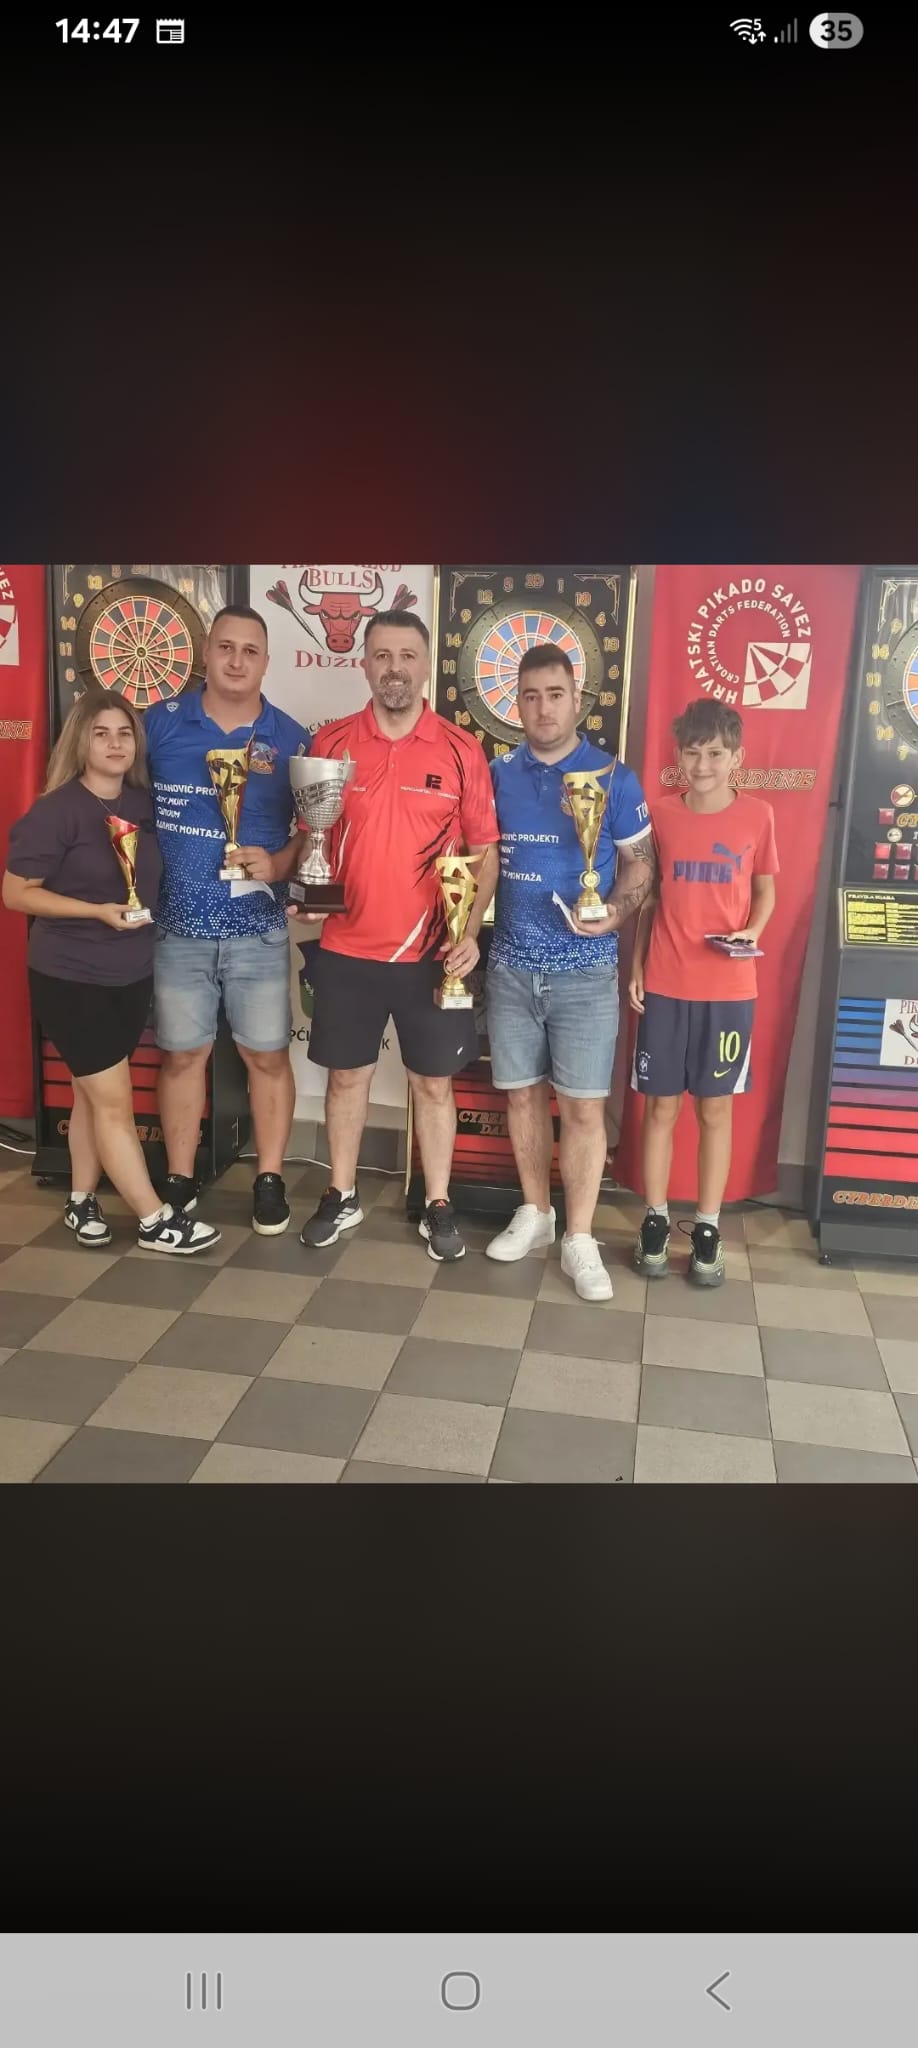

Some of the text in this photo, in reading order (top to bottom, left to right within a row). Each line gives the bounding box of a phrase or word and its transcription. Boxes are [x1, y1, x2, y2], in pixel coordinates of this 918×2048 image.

[308, 568, 373, 589] BULLS
[445, 633, 462, 648] 14
[687, 578, 812, 704] HRVATSKI PIKADO SAVEZ
[706, 599, 791, 684] CROATIAN DARTS FEDERATION
[660, 766, 817, 791] CYRDINE
[195, 786, 218, 797] PRO
[180, 825, 227, 840] MONTAŽA
[518, 833, 560, 844] PROJEKTI
[673, 860, 732, 884] PUMA
[719, 1031, 741, 1063] 10
